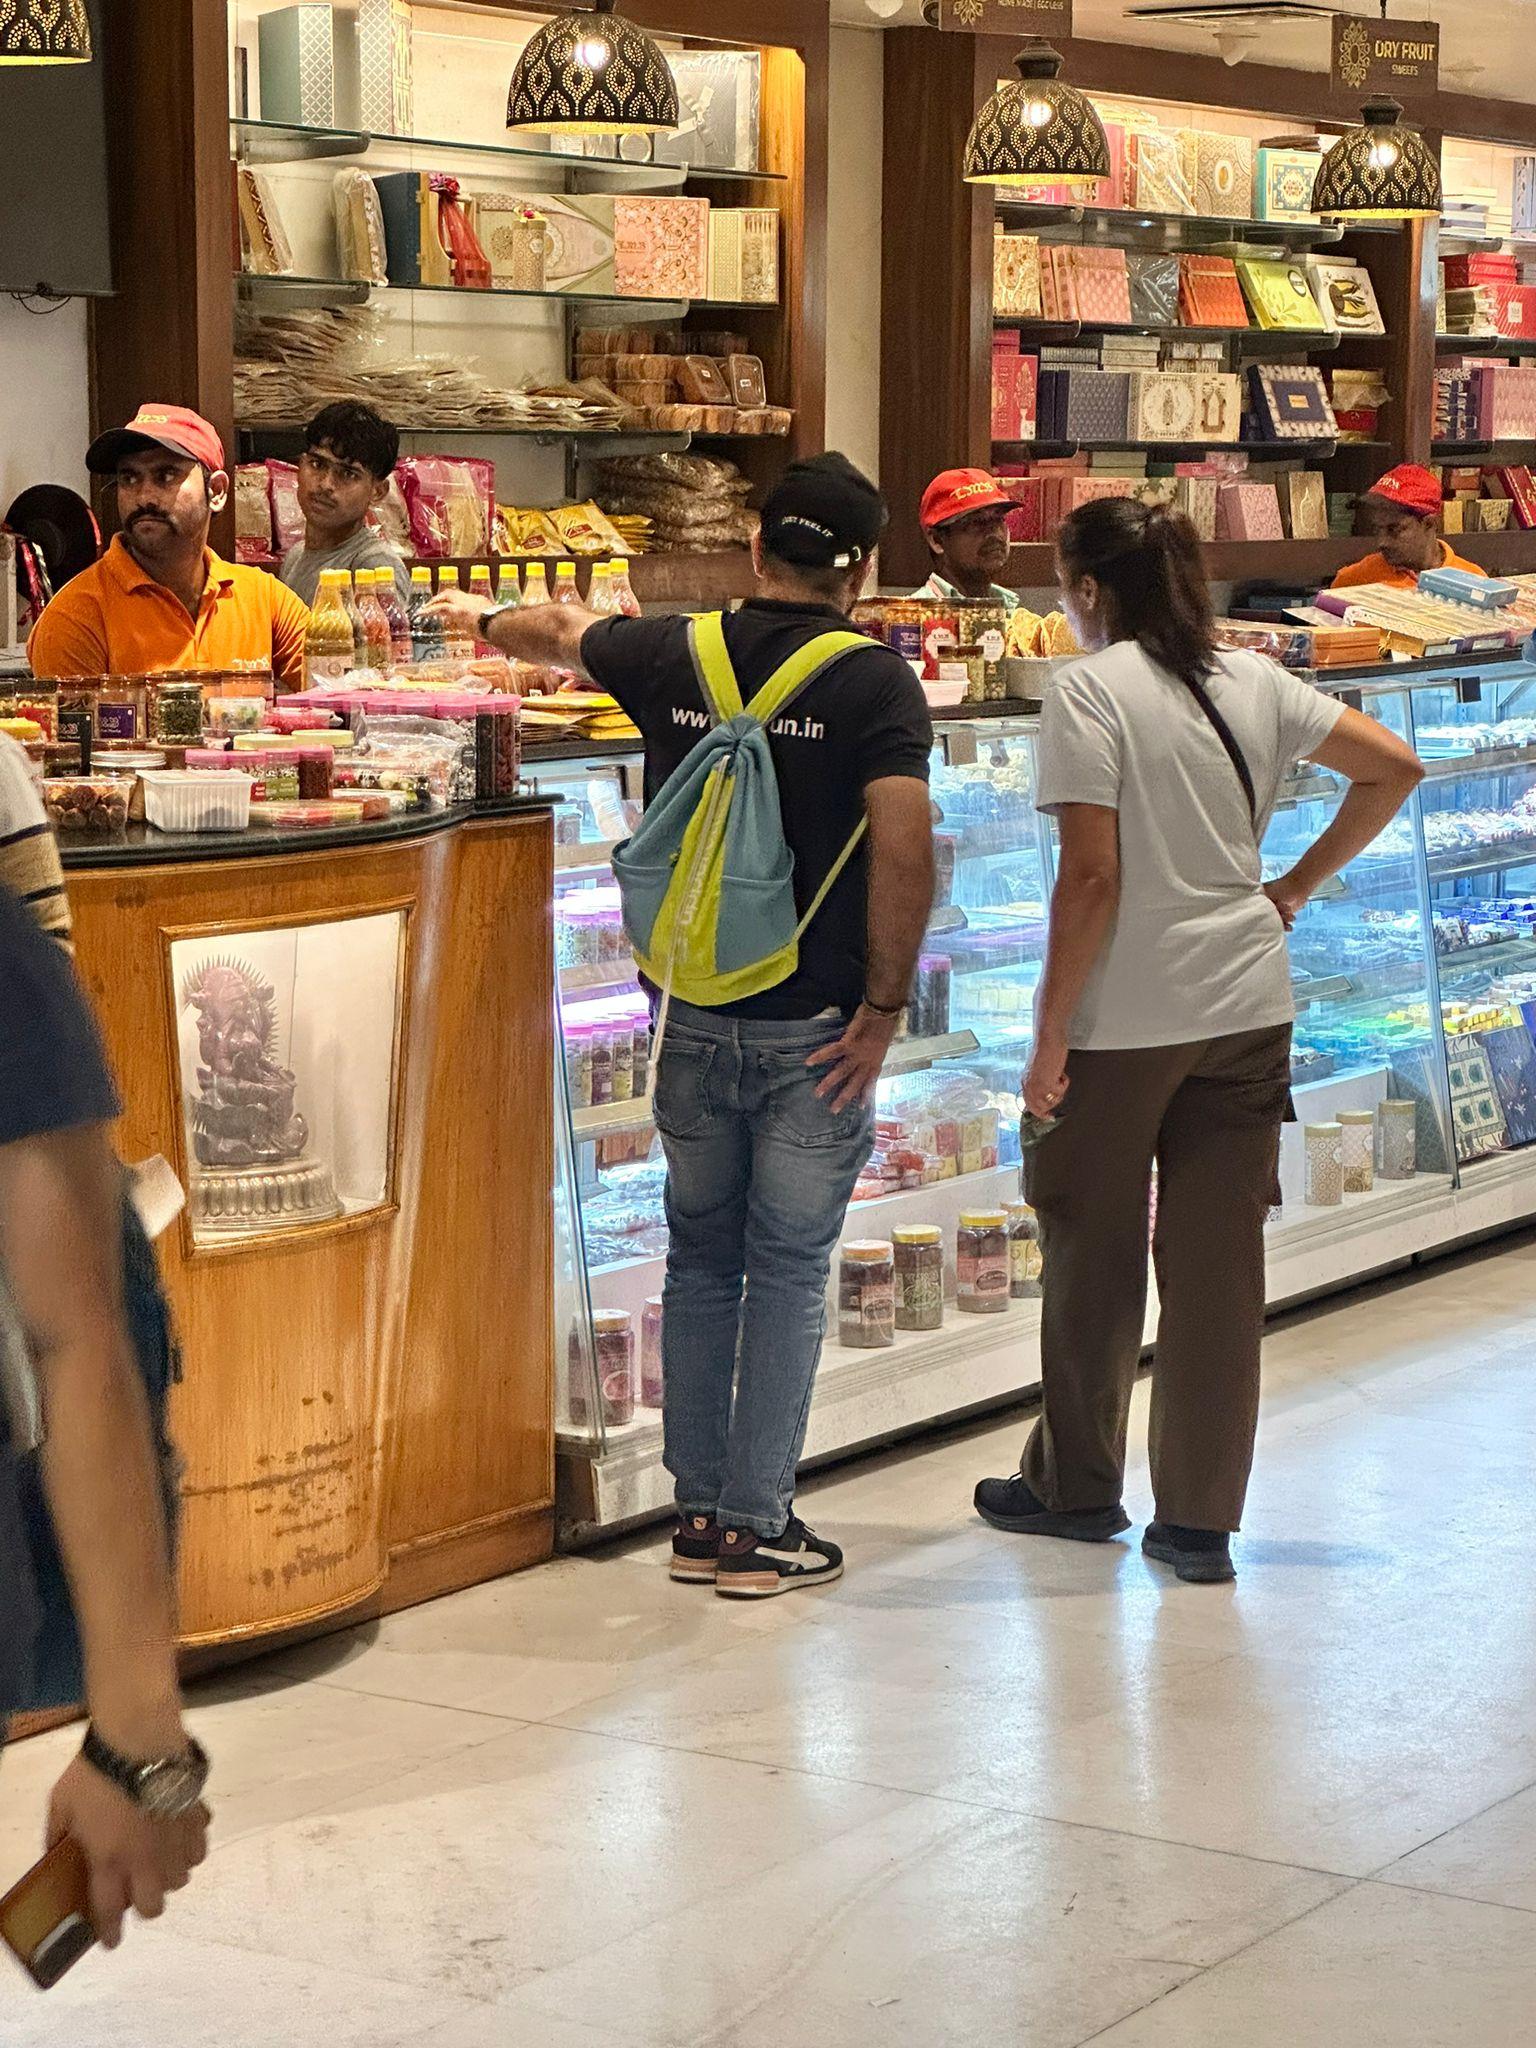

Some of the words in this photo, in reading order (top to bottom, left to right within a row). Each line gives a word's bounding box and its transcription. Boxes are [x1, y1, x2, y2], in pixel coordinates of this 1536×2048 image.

[1374, 40, 1399, 58] DRY
[1401, 42, 1436, 60] FRUIT
[1391, 64, 1419, 76] SWEETS
[799, 517, 822, 532] FEEL
[821, 528, 834, 537] IT
